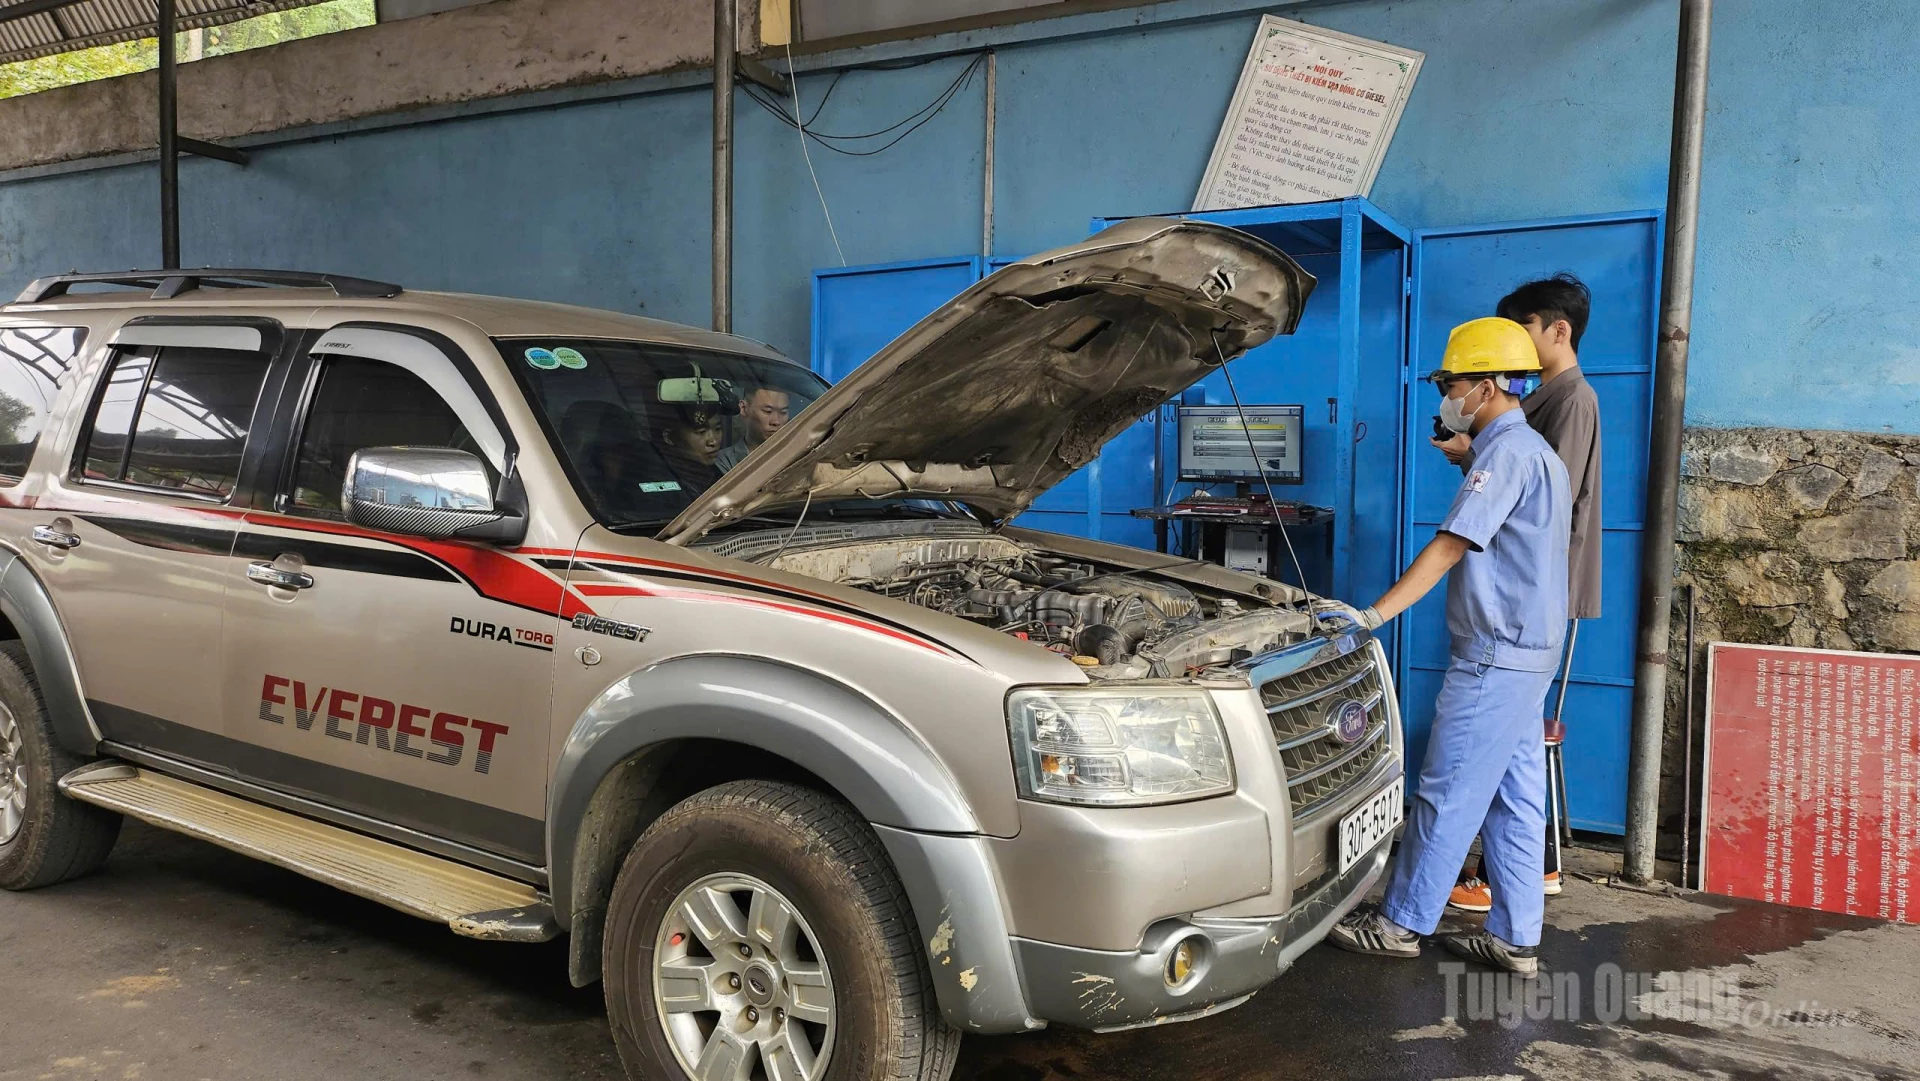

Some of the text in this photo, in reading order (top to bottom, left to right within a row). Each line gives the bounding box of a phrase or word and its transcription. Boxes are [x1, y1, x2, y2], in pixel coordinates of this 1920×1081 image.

[571, 613, 653, 643] EVEREST
[1771, 676, 1783, 694] phạm
[1804, 685, 1814, 697] cho
[1837, 682, 1846, 690] tra
[1883, 678, 1896, 695] dụng
[1821, 688, 1831, 698] Khi
[1802, 699, 1814, 718] người
[1817, 700, 1831, 708] hệ
[1883, 697, 1896, 711] điện
[259, 674, 509, 774] EVEREST
[1817, 710, 1831, 729] thống
[1834, 718, 1846, 732] điện
[1884, 713, 1896, 732] chiếu
[1772, 727, 1781, 739] các
[1785, 724, 1798, 737] việc
[1817, 731, 1830, 745] điện
[1850, 724, 1863, 738] điện
[1784, 749, 1796, 765] dụng
[1800, 748, 1813, 768] nhiệm
[1882, 758, 1896, 773] phải
[1768, 770, 1781, 784] điện
[1769, 798, 1779, 813] theo
[1847, 799, 1862, 811] sấy
[1895, 695, 1914, 907] Không được thay đổi hệ thống bộ phận
[1883, 804, 1893, 817] cho
[1830, 811, 1843, 828] cháy
[1849, 818, 1860, 829] nơi
[1765, 832, 1778, 840] độ
[1781, 827, 1793, 846] người
[1812, 835, 1826, 856] không
[1845, 841, 1857, 858] nguy
[1882, 841, 1892, 850] có
[1781, 848, 1794, 863] phải
[1881, 852, 1892, 869] trách
[1848, 859, 1861, 876] hiểm
[1780, 865, 1792, 890] nghiêm
[1879, 871, 1892, 893] nhiệm
[1844, 877, 1858, 894] cháy
[1781, 891, 1791, 902] túc
